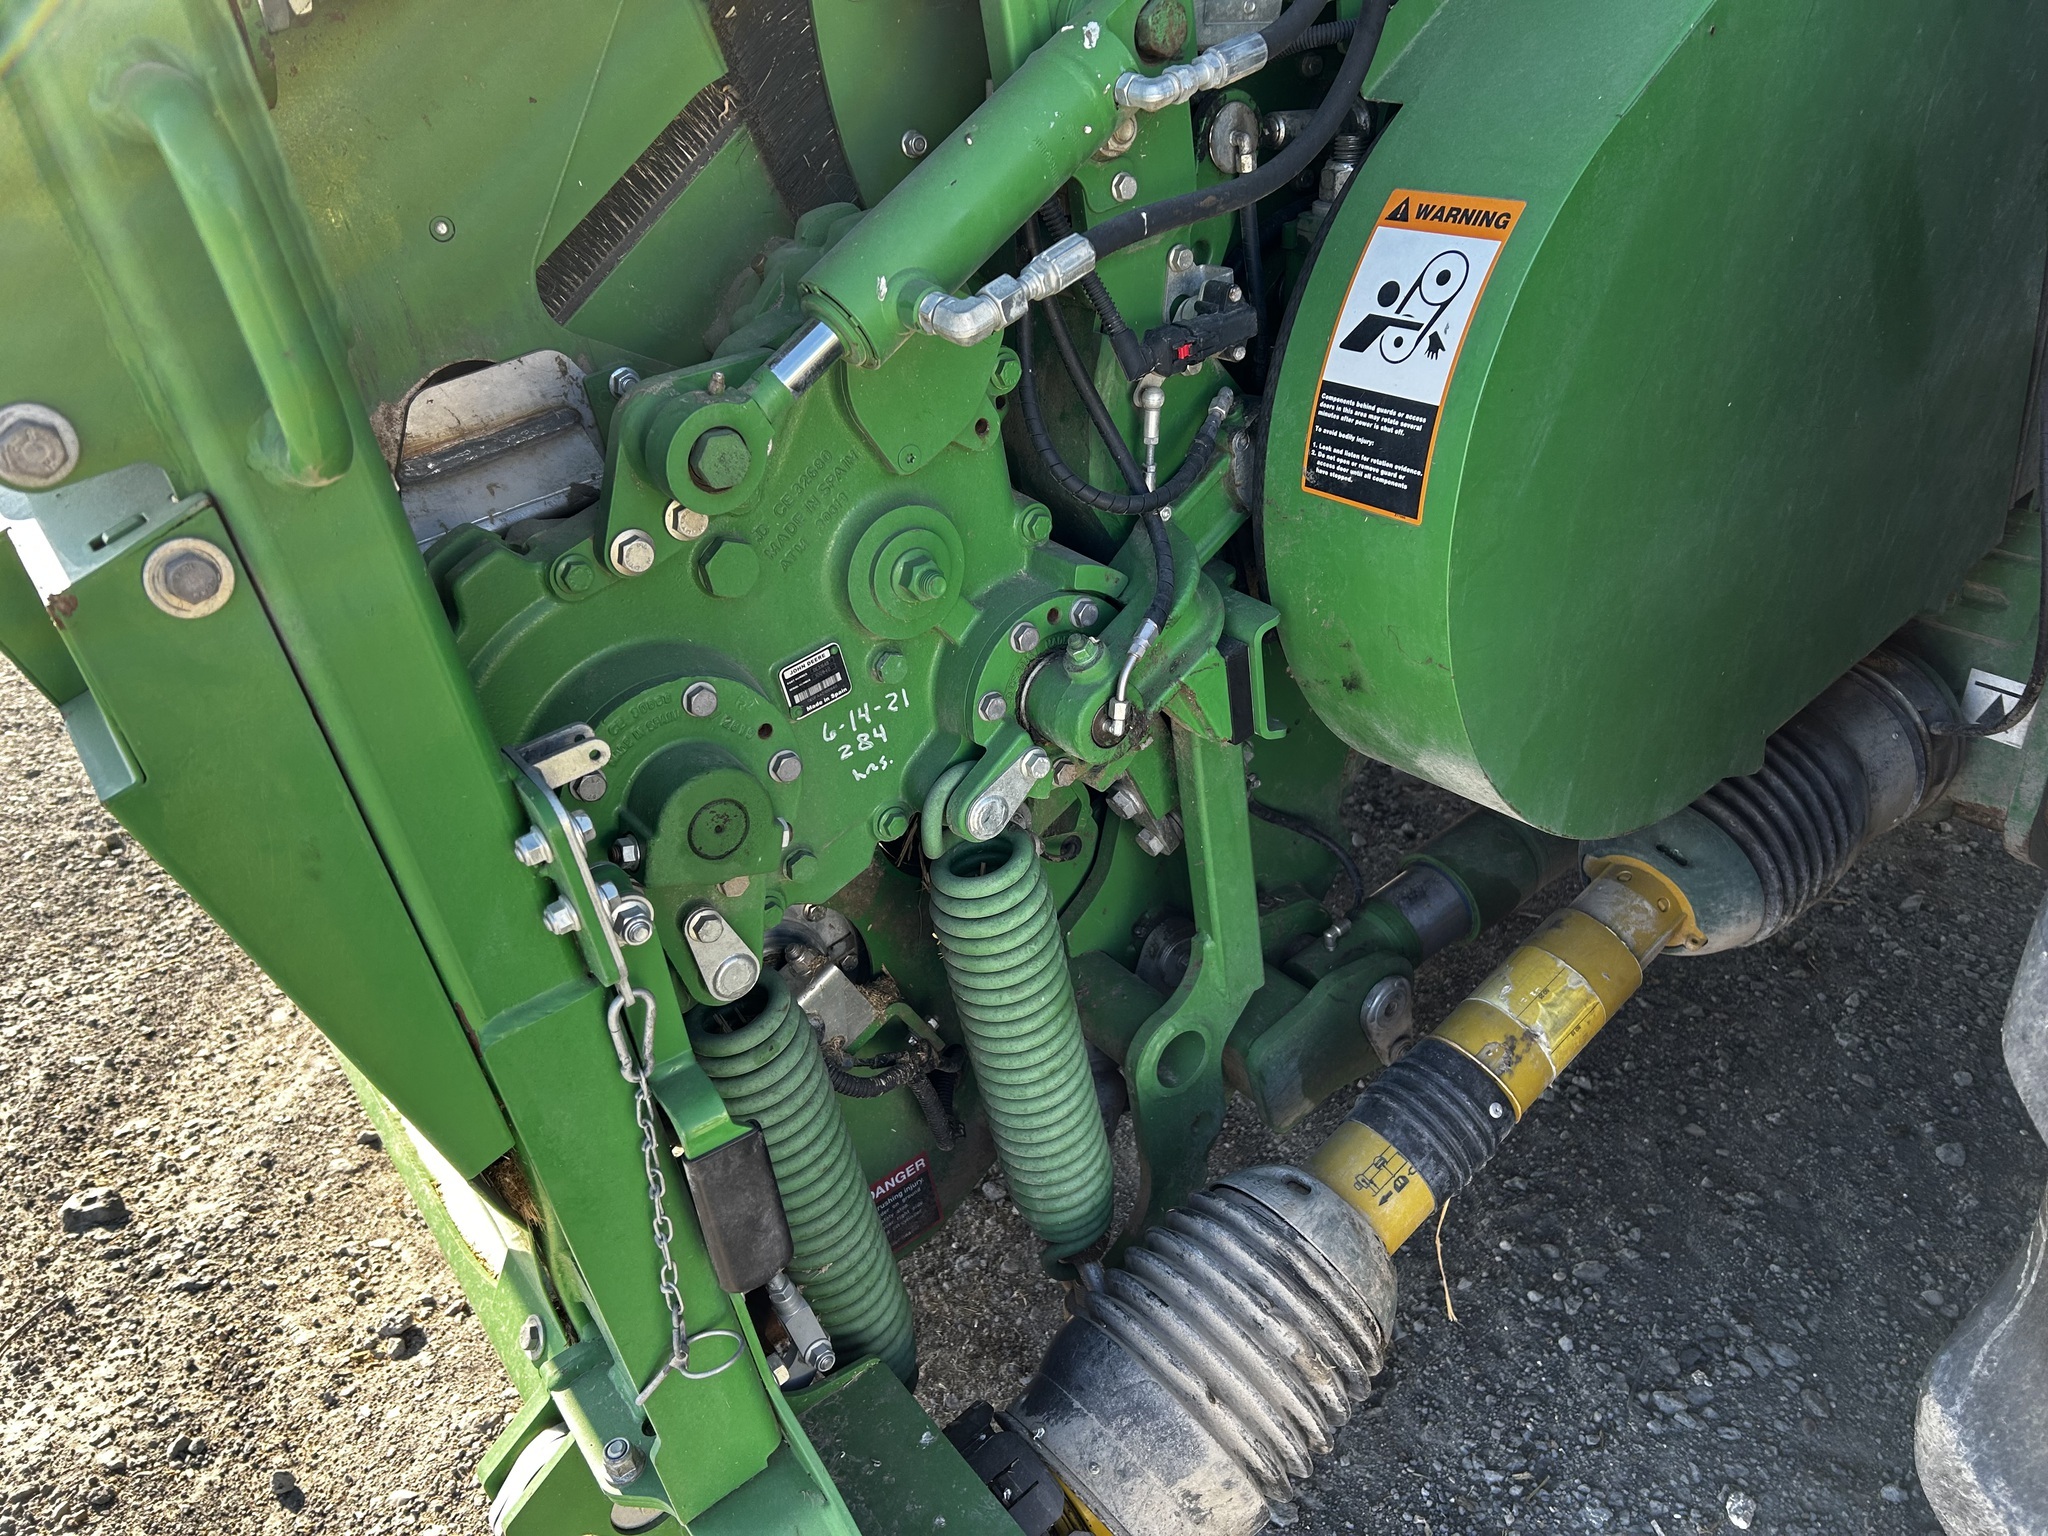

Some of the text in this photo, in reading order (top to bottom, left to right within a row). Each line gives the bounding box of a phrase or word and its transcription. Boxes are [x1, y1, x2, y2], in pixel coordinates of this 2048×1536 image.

[1415, 203, 1512, 230] WARNING
[1320, 402, 1336, 411] doors
[1343, 406, 1353, 415] this
[1354, 410, 1368, 418] area
[1368, 413, 1380, 422] may
[1381, 416, 1399, 425] rotate
[1400, 420, 1422, 431] several
[1321, 393, 1355, 406] Components
[1356, 401, 1376, 411] behind
[1376, 406, 1396, 416] guards
[1405, 413, 1426, 423] access
[1318, 410, 1339, 420] minutes
[1341, 414, 1354, 424] after
[1355, 419, 1372, 428] power
[1381, 425, 1394, 433] shut
[1395, 428, 1404, 436] off.
[1323, 428, 1338, 437] avoid
[1338, 430, 1356, 442] bodily
[1356, 436, 1374, 446] injury:
[1319, 443, 1332, 452] Look
[1333, 446, 1343, 455] and
[1344, 449, 1359, 459] listen
[1360, 454, 1370, 462] for
[1371, 457, 1393, 469] rotation
[1394, 464, 1422, 476] evidence.
[1326, 453, 1336, 462] not
[1336, 457, 1350, 466] open
[1358, 462, 1379, 473] remove
[1380, 468, 1398, 479] guard
[1316, 460, 1335, 470] access
[1336, 465, 1350, 474] door
[1350, 468, 1363, 478] until
[1372, 475, 1408, 490] components
[1316, 467, 1353, 483] have stopped.
[764, 449, 858, 559] MADE IN SPAIN
[773, 492, 794, 517] CE
[790, 663, 805, 675] JOHN
[807, 654, 825, 666] DEERE
[806, 700, 823, 711] Made
[831, 687, 847, 698] Spain
[823, 688, 910, 741] 6-14-21
[838, 724, 888, 761] 284
[877, 1191, 903, 1210] rushing
